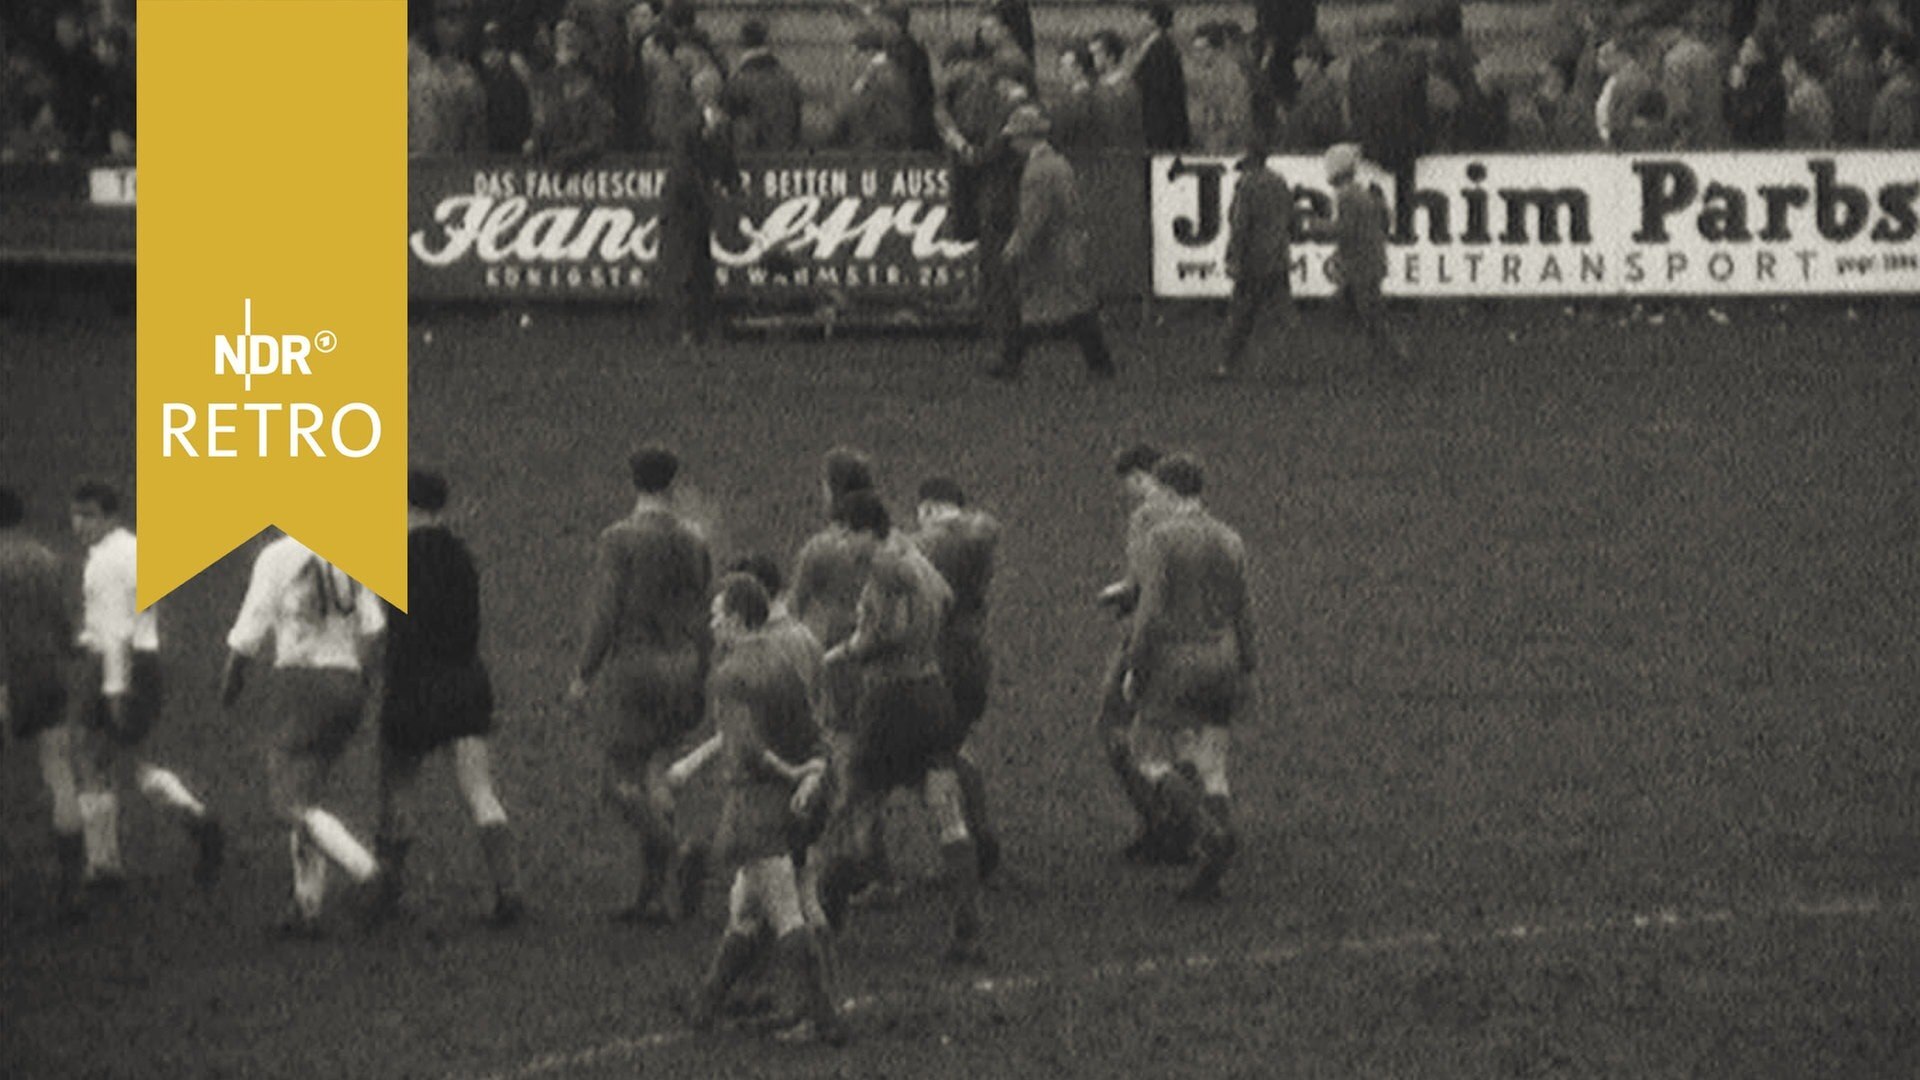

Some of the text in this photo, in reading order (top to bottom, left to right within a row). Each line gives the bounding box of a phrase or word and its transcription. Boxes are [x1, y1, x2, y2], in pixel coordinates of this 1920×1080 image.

[473, 170, 516, 198] DAS
[764, 168, 848, 198] BETTEN
[891, 168, 949, 198] AUSS
[1166, 156, 1920, 246] Jahim Parbs
